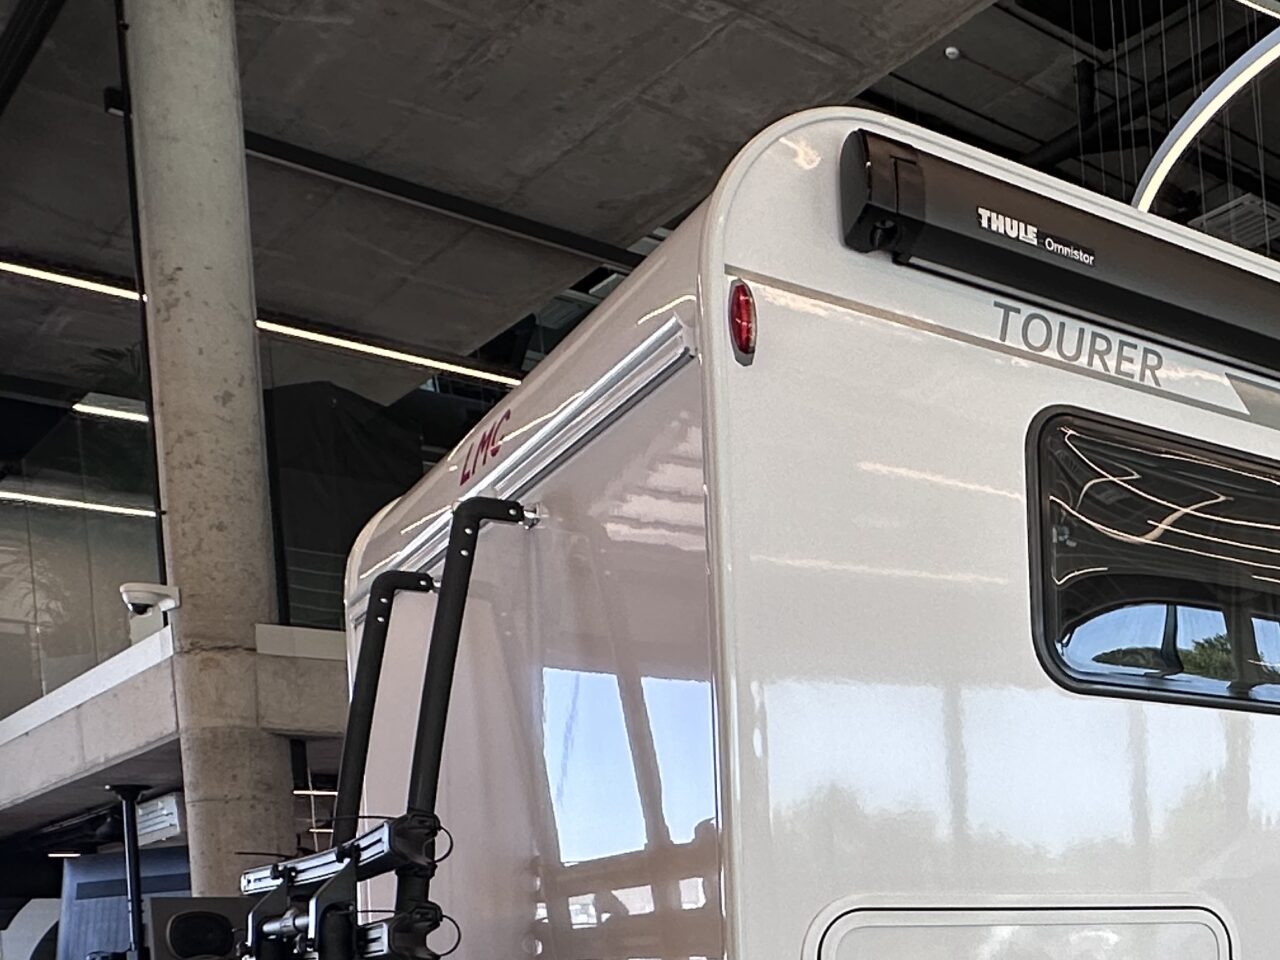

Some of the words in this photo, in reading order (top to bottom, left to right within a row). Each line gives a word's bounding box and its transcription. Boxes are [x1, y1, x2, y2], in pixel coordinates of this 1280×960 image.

[977, 207, 1038, 246] THULE
[1045, 237, 1095, 265] Omnistor
[993, 300, 1163, 387] TOURER
[459, 408, 511, 487] LMC
